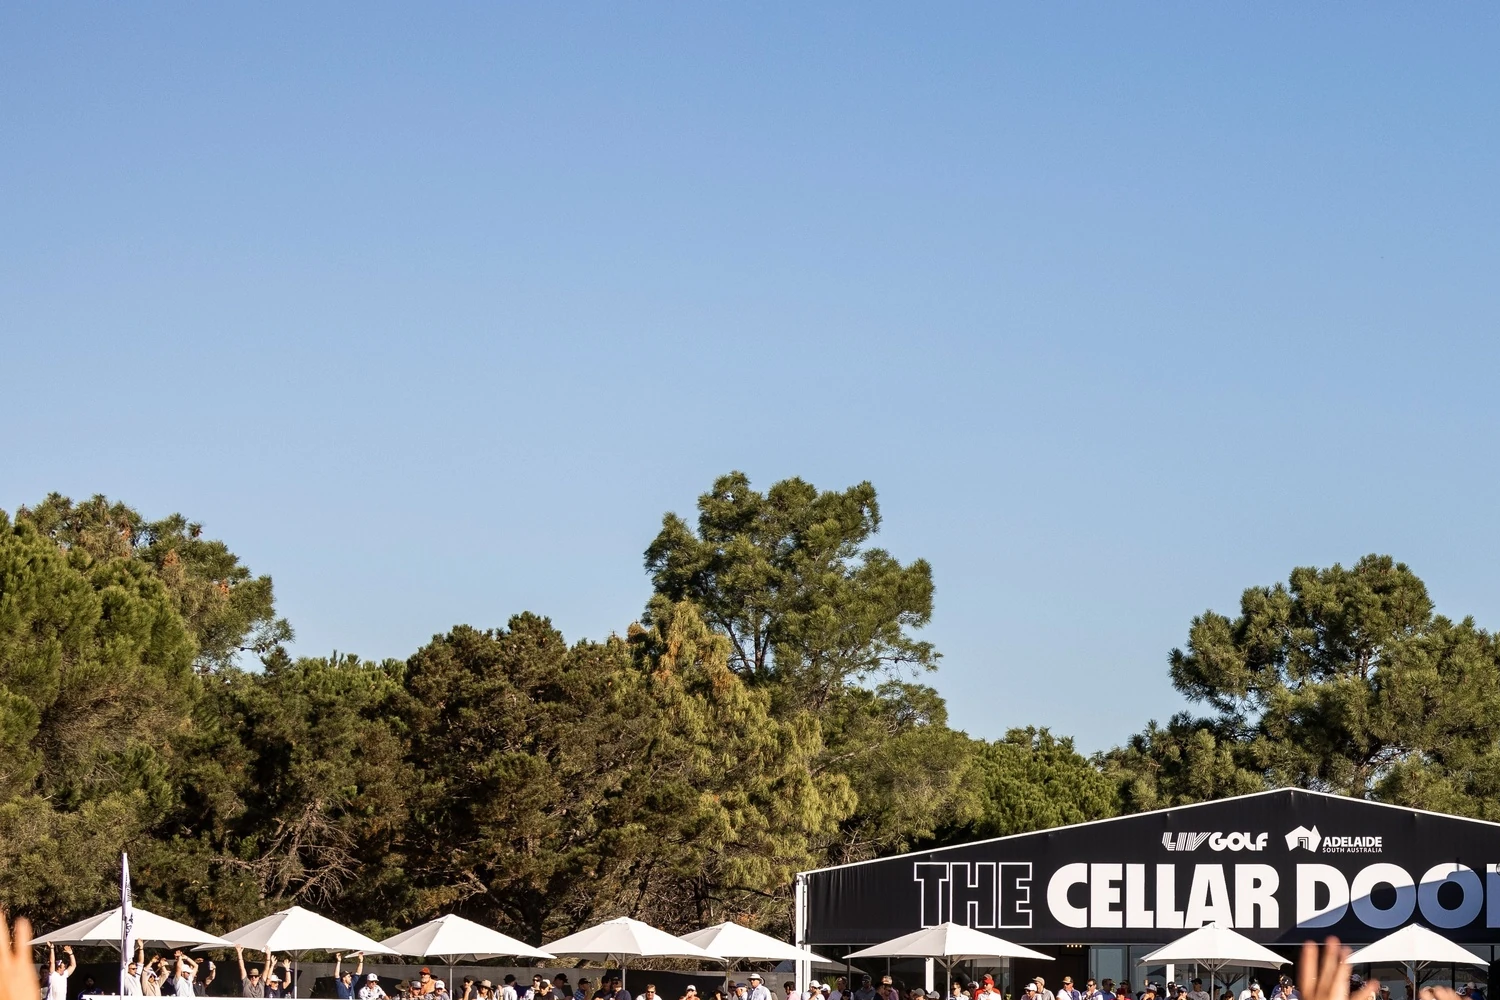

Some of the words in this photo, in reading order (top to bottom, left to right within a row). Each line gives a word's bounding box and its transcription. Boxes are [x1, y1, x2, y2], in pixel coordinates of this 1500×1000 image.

[1323, 836, 1382, 847] ADELAIDE
[914, 862, 1032, 928] THE
[1047, 862, 1279, 929] CELLAR
